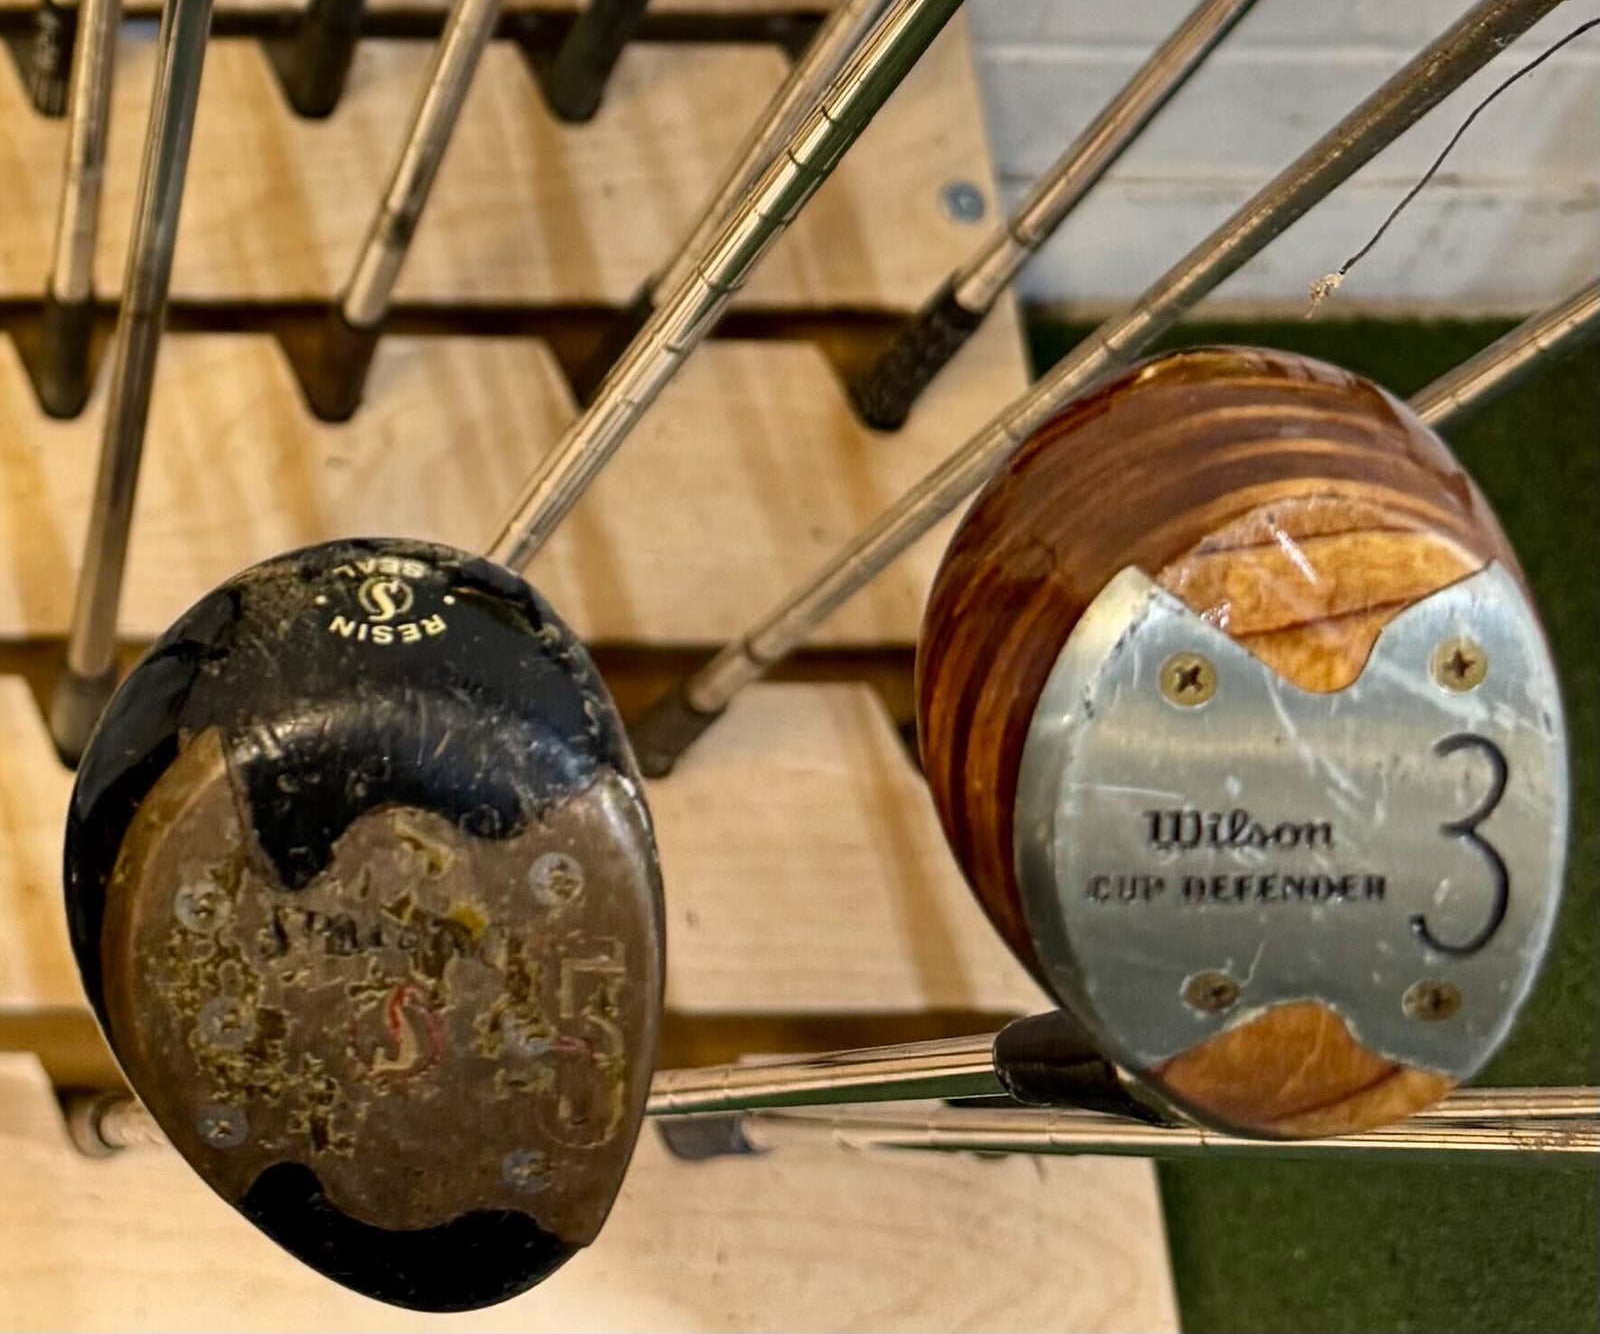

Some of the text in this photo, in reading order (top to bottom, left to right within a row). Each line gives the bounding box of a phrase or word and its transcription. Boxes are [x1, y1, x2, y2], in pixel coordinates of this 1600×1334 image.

[331, 556, 427, 579] SEAL
[328, 613, 448, 646] RESIN
[1143, 808, 1334, 850] Wilson
[1409, 733, 1509, 957] 3
[1086, 873, 1387, 901] CUP DEFENDER
